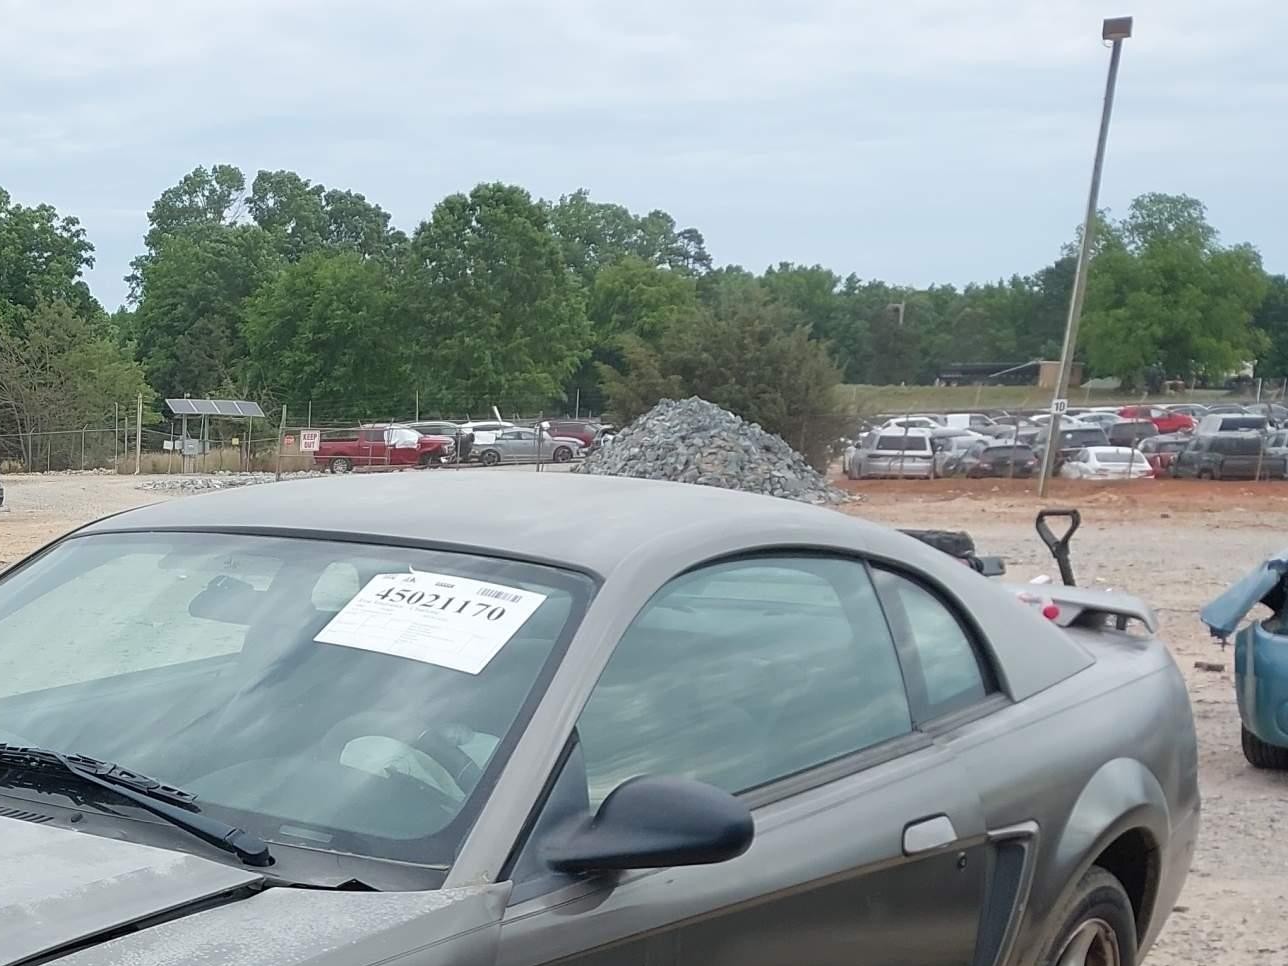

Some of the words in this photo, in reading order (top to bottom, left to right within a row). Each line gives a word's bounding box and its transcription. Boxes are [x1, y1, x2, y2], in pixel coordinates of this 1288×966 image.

[1054, 401, 1065, 412] 10
[302, 433, 318, 441] KEEP
[376, 586, 507, 621] 45021170
